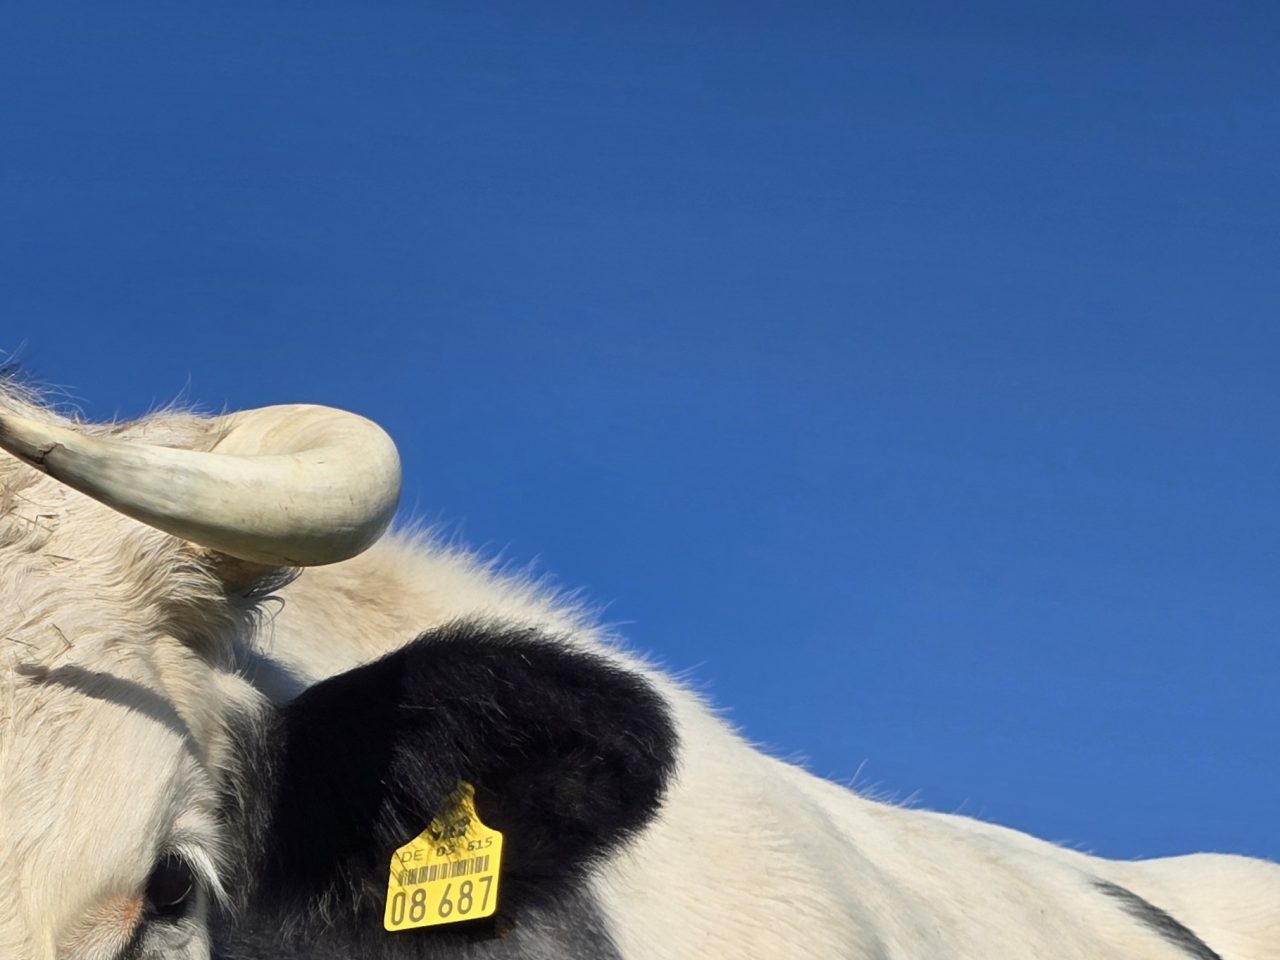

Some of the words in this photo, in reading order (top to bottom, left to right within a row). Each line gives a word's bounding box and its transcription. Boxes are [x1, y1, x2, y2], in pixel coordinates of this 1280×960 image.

[401, 849, 424, 863] DE
[391, 888, 426, 925] 08
[438, 876, 493, 918] 687
